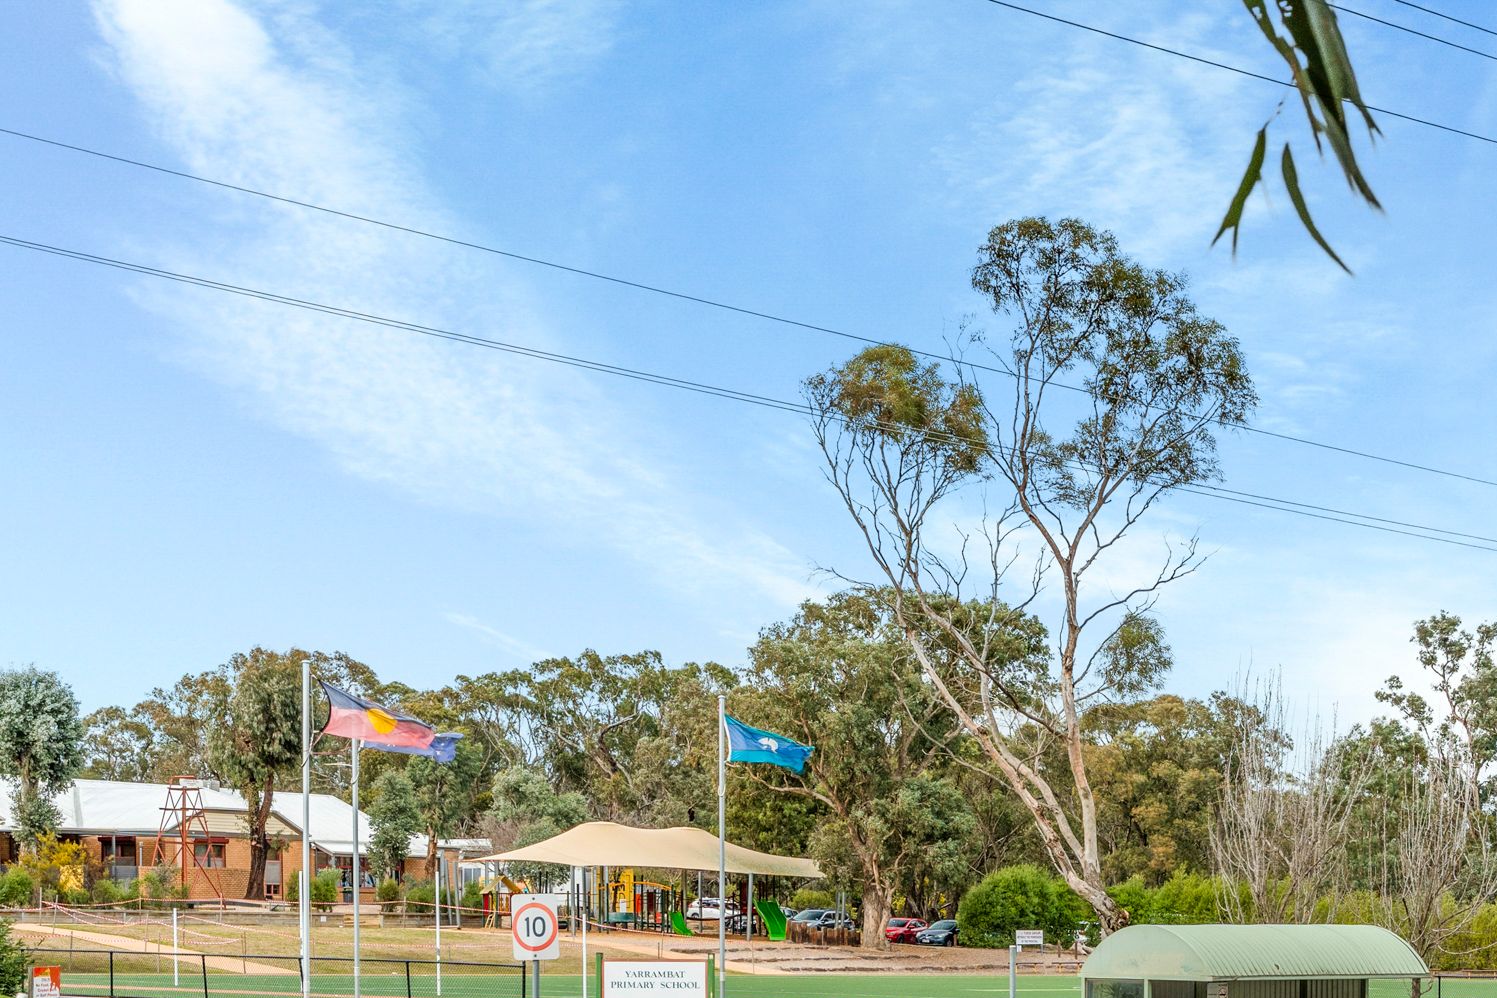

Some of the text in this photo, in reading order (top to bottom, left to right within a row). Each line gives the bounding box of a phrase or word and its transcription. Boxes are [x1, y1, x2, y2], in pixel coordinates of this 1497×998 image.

[524, 916, 546, 938] 10
[626, 970, 686, 978] YARRAMBAT
[610, 981, 701, 989] PRIMARY SCHOOL
